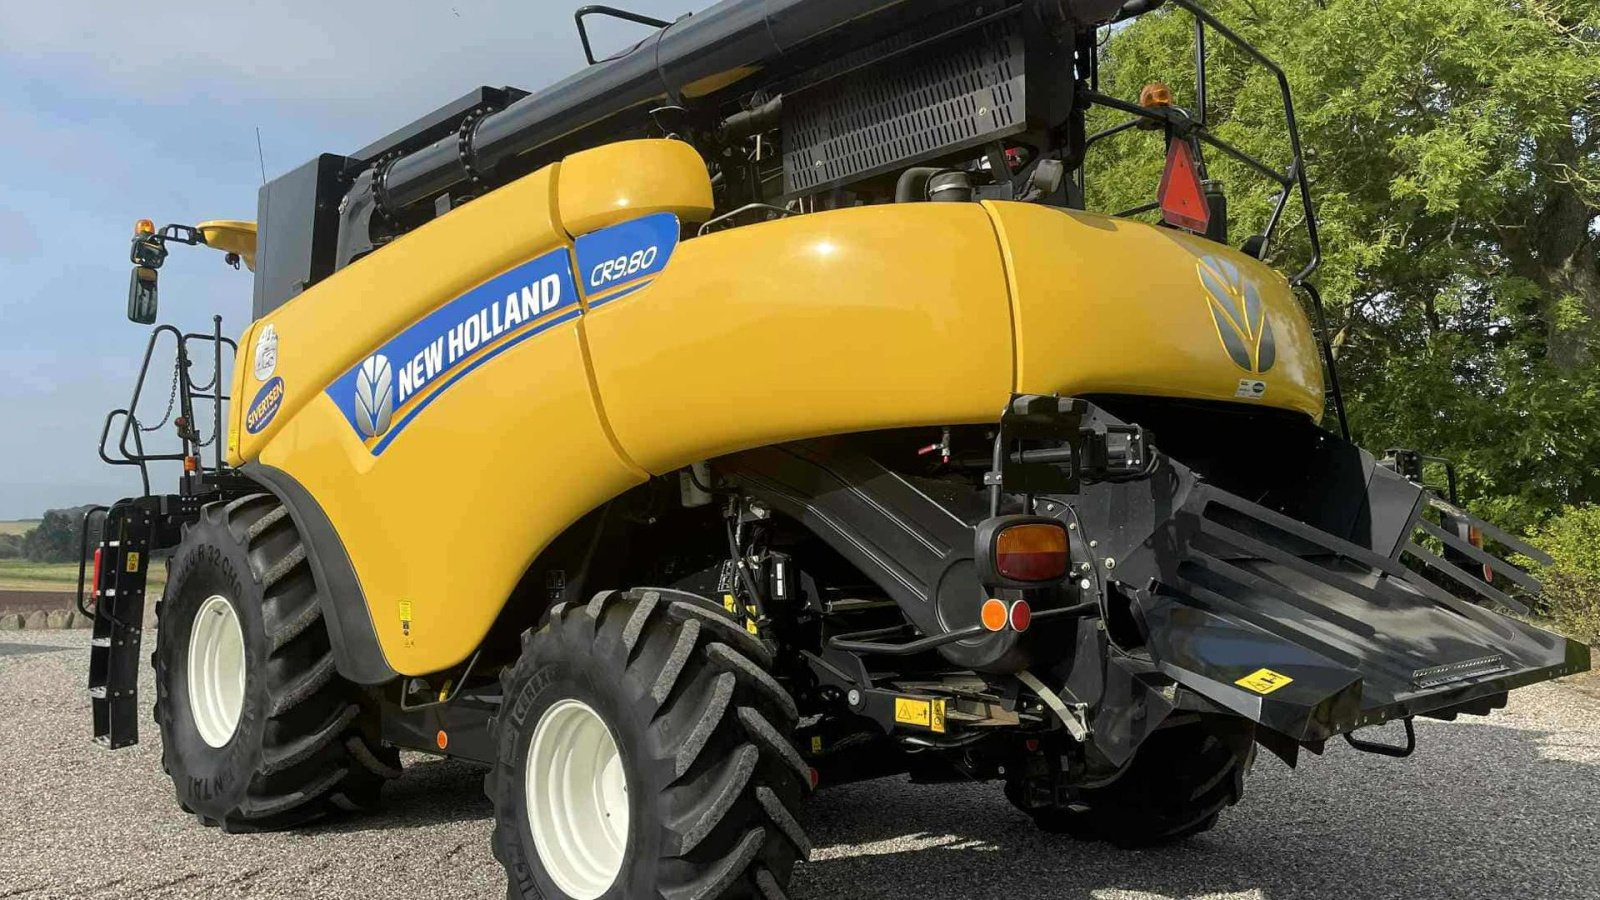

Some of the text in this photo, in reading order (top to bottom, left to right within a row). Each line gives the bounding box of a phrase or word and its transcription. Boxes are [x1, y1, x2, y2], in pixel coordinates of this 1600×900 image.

[590, 246, 658, 287] CR9.80
[398, 273, 561, 402] NEW HOLLAND
[247, 379, 283, 429] SIVERTSEN
